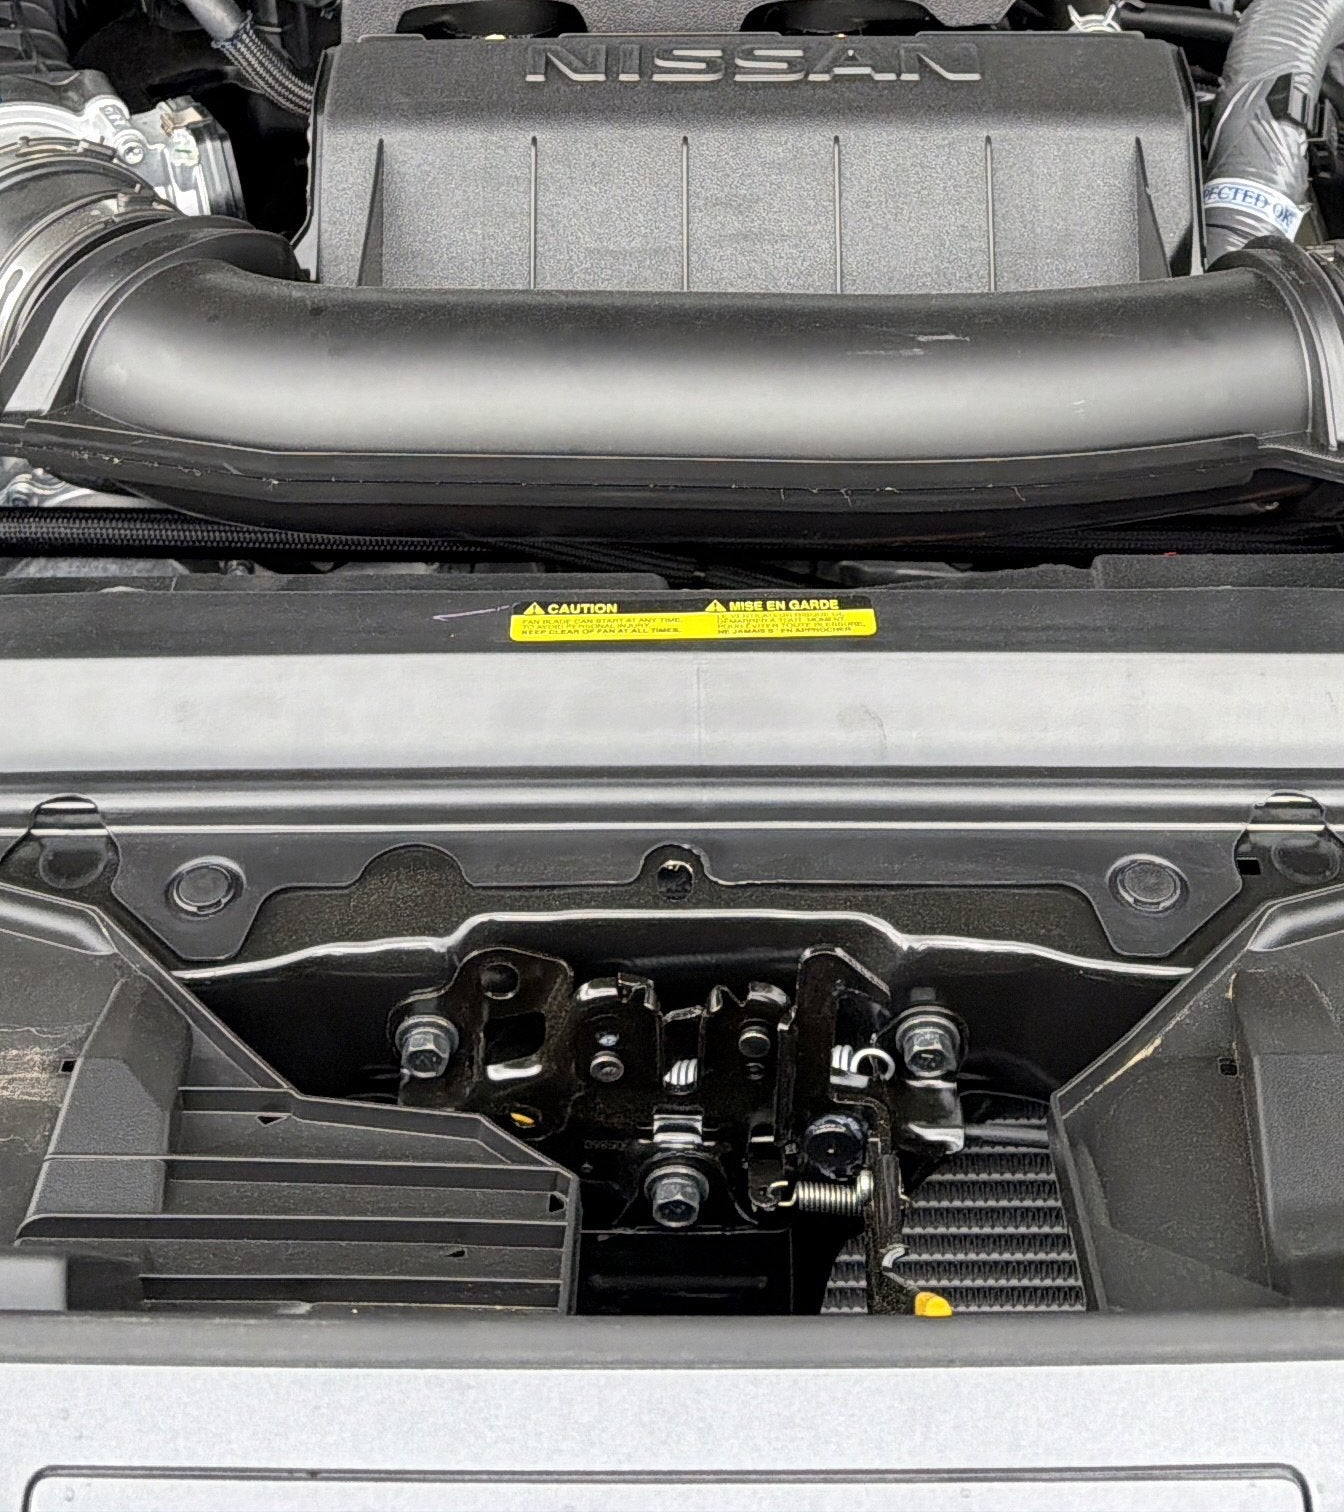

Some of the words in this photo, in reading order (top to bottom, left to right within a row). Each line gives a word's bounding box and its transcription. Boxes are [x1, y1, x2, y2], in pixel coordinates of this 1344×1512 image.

[524, 44, 982, 82] NISSAN
[547, 603, 618, 614] CAUTION
[729, 600, 764, 611] MISE
[766, 600, 786, 611] EN
[789, 599, 840, 610] GARDE
